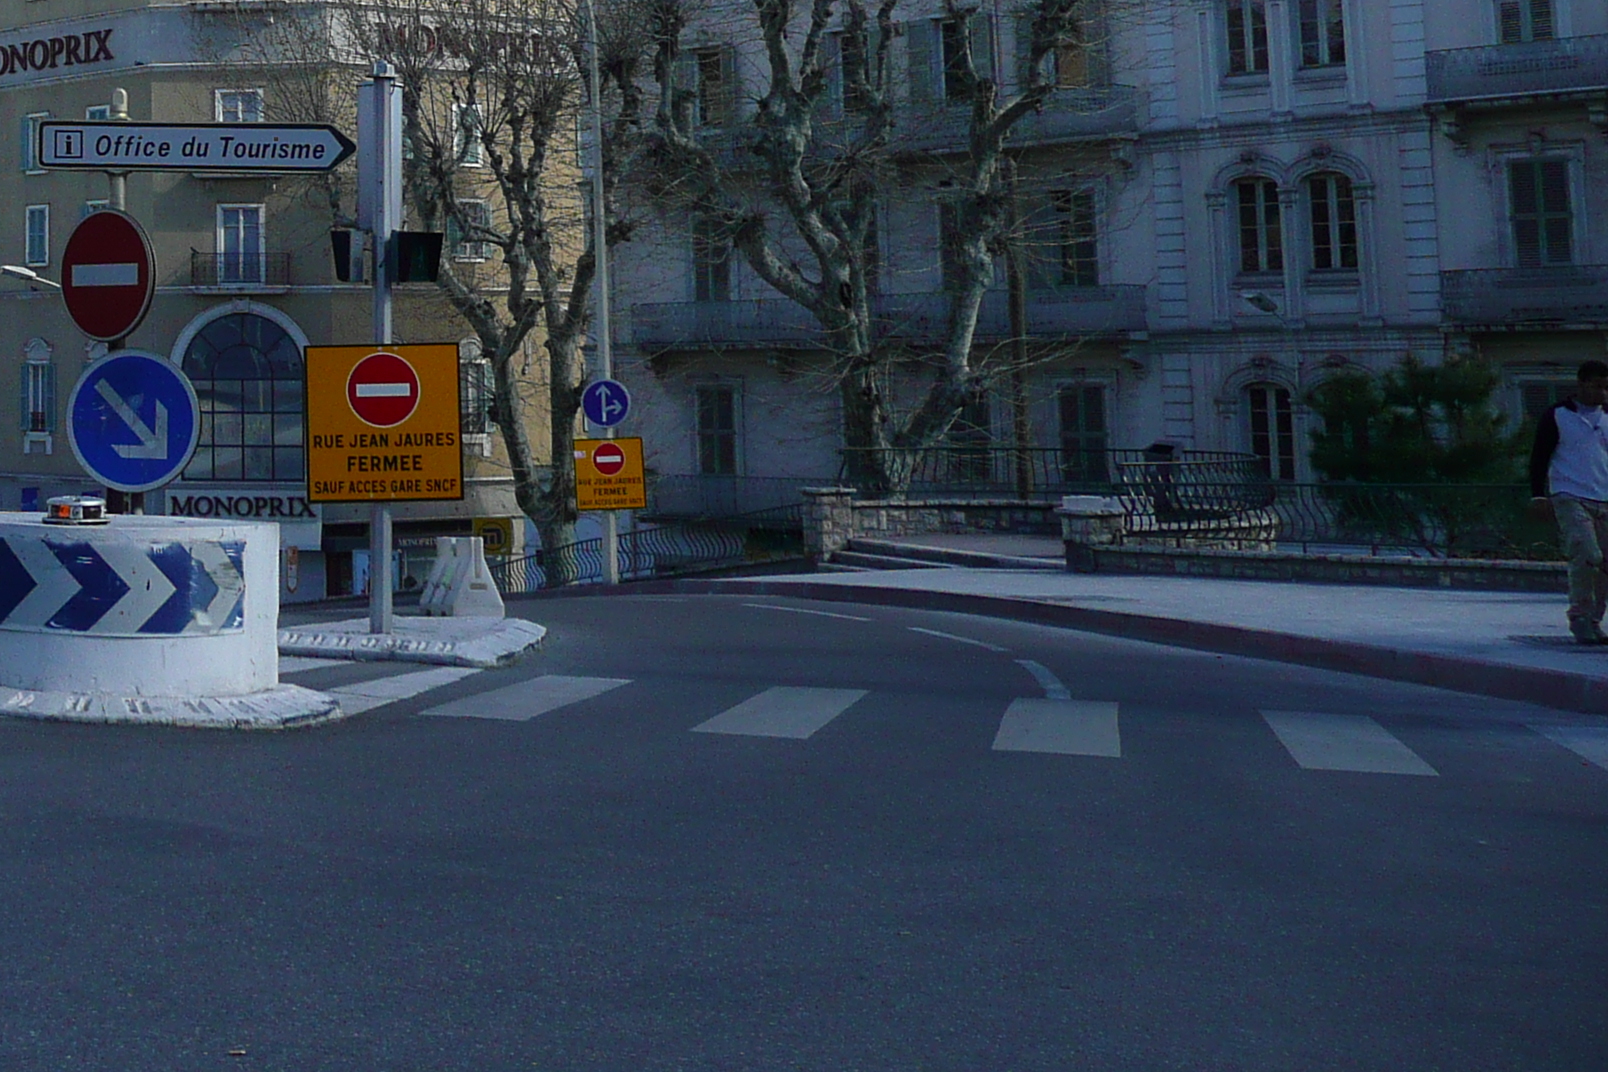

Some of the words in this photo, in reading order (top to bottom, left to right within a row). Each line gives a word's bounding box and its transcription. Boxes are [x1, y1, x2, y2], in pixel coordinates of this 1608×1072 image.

[95, 135, 170, 158] Office
[181, 135, 209, 158] du
[220, 136, 325, 159] Tourisme
[313, 434, 344, 448] RUE
[349, 434, 389, 448] JEAN
[394, 432, 455, 447] JAURES
[347, 455, 423, 472] FERMEE
[314, 481, 344, 494] SAUF
[349, 480, 386, 493] ACCES
[390, 480, 421, 492] GARE
[425, 479, 457, 492] SNCF
[594, 487, 628, 496] FERMEE
[170, 495, 316, 518] MONOPRIX
